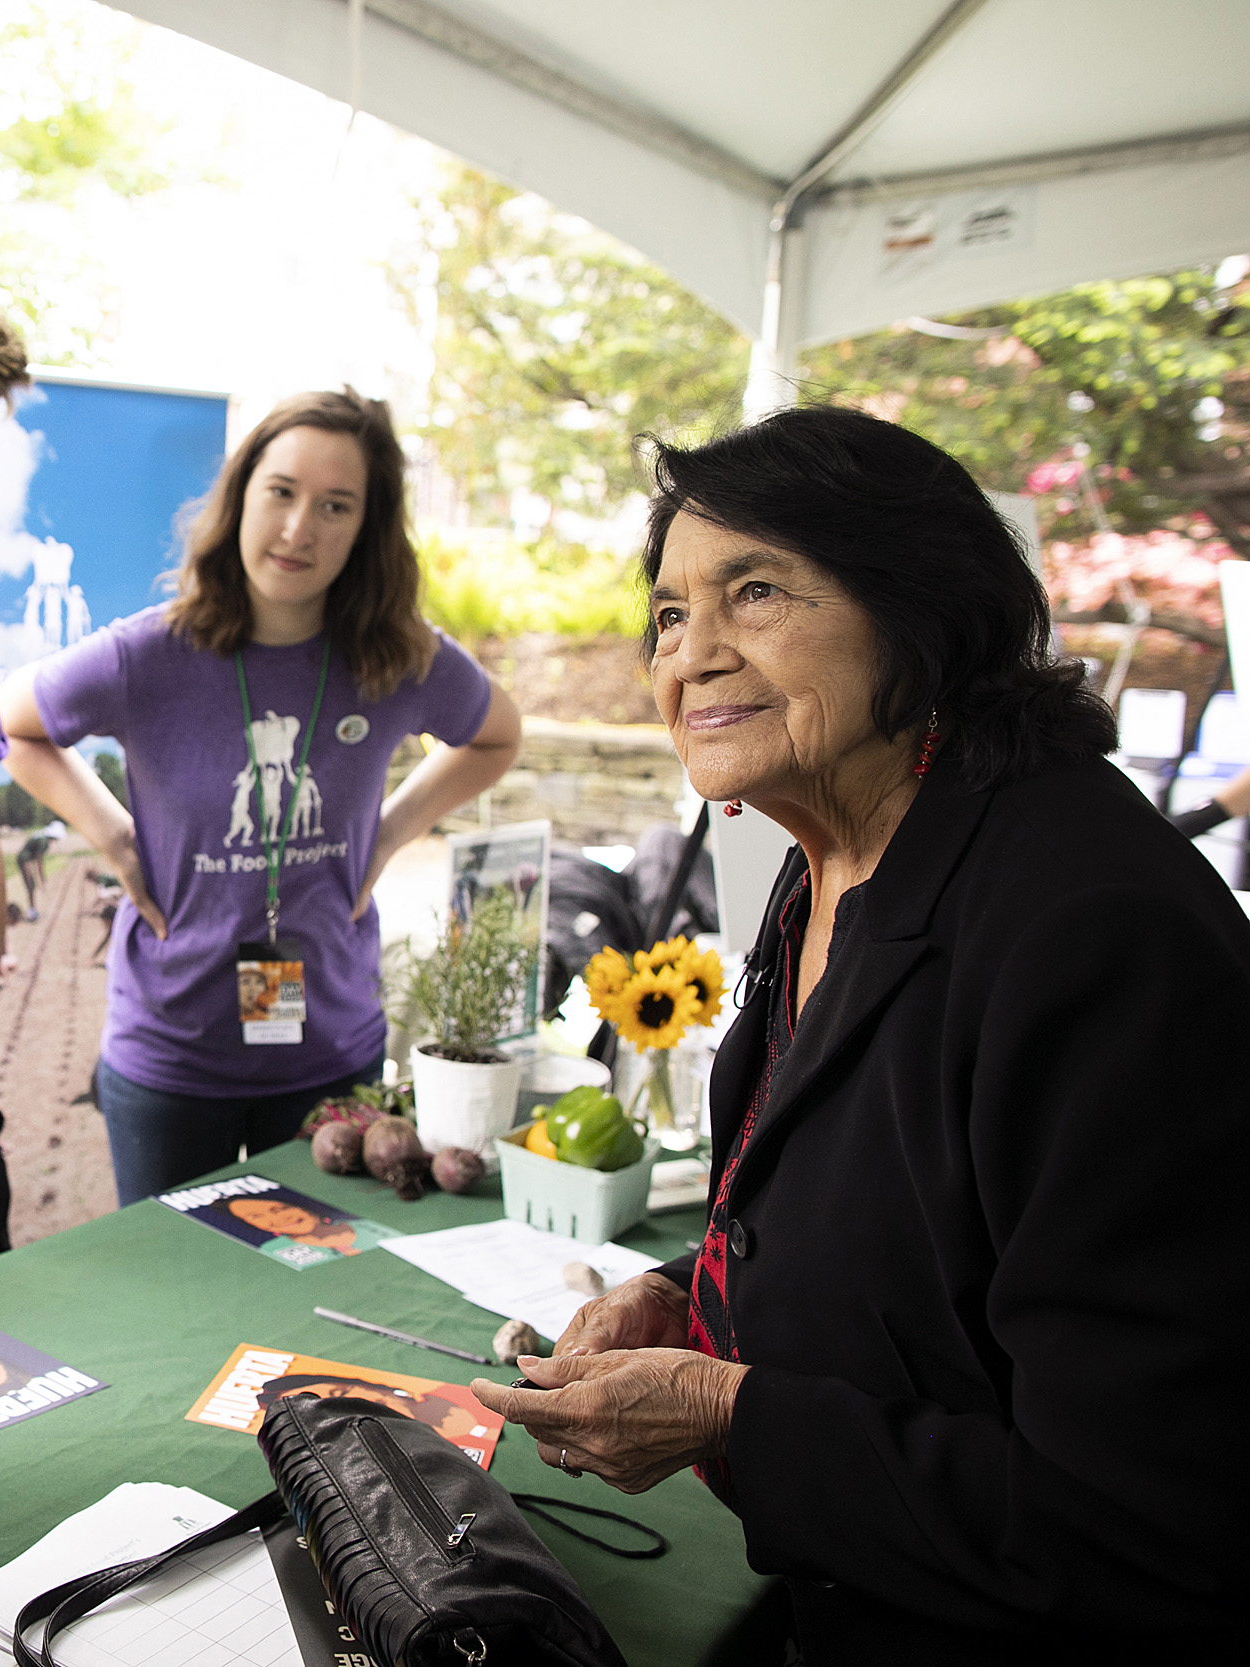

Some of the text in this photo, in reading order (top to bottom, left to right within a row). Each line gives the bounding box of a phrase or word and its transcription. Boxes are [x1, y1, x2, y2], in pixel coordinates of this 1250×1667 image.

[193, 853, 226, 873] The
[284, 841, 348, 866] Project
[198, 1350, 295, 1429] HUERTA
